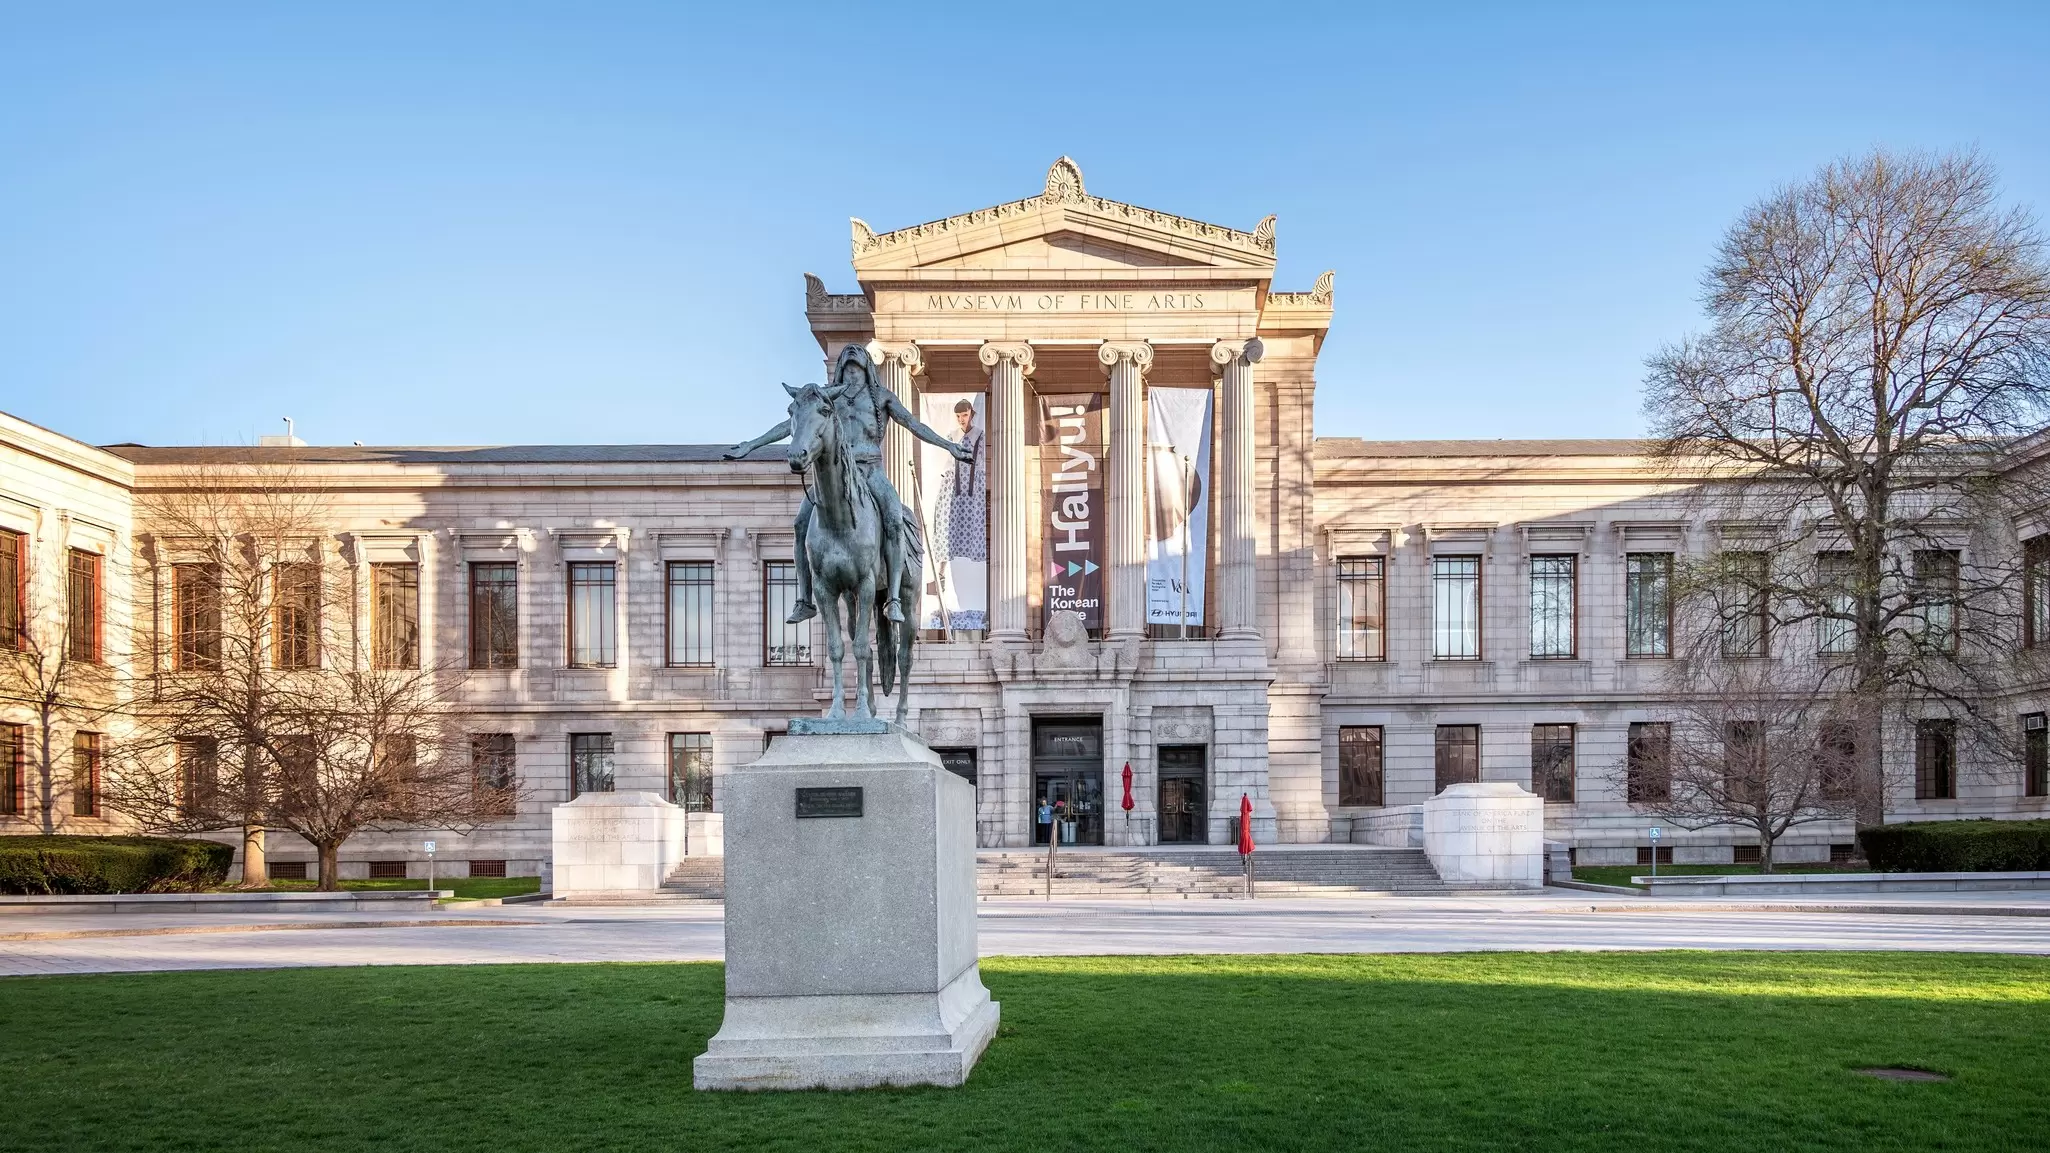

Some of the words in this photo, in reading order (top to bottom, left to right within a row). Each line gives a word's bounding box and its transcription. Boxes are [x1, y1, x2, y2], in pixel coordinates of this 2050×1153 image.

[928, 295, 1022, 310] MVSEVM
[1038, 295, 1065, 310] OF
[1081, 294, 1133, 309] FINE
[1147, 293, 1204, 309] ARTS
[1049, 585, 1075, 597] The
[1051, 597, 1099, 609] Korean
